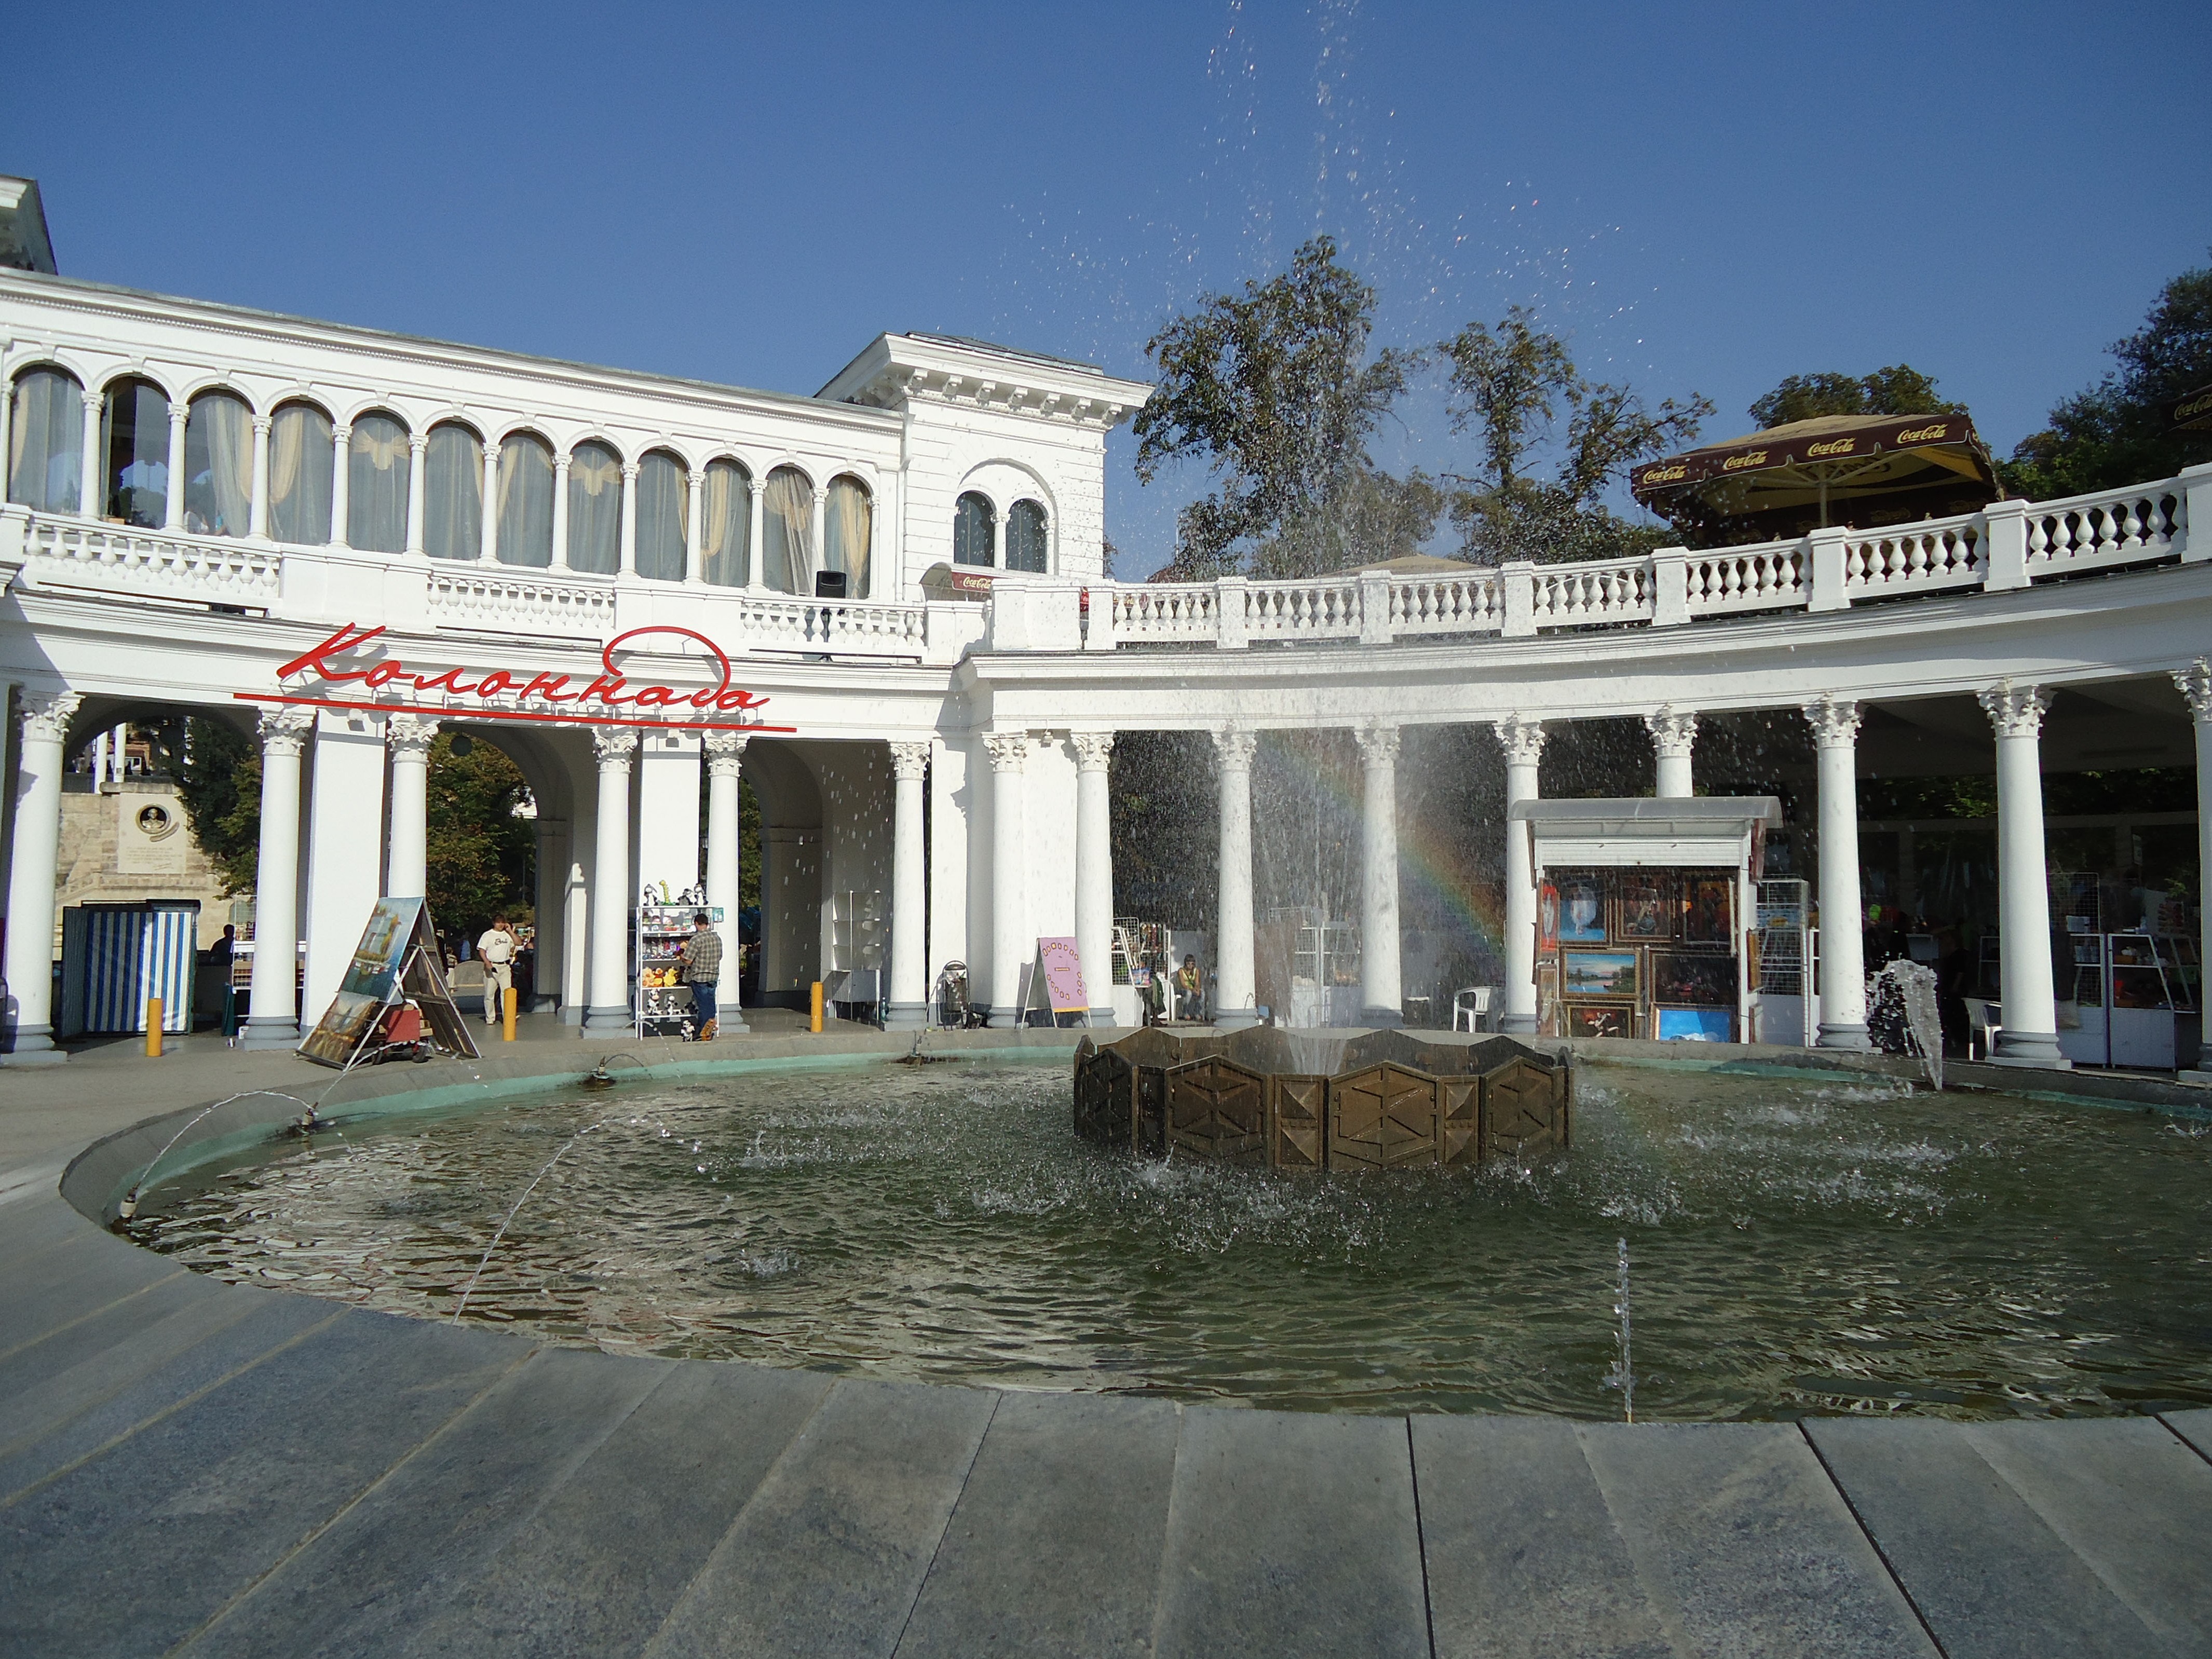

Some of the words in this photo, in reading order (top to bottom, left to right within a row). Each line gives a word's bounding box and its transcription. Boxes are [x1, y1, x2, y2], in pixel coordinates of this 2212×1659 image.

[1897, 424, 1948, 444] Coca-Cola
[1807, 438, 1856, 457] Coca-Cola
[1722, 451, 1769, 470] Coca-Cola
[1643, 465, 1687, 484] Coca-Cola
[276, 622, 770, 710] Колоннада
